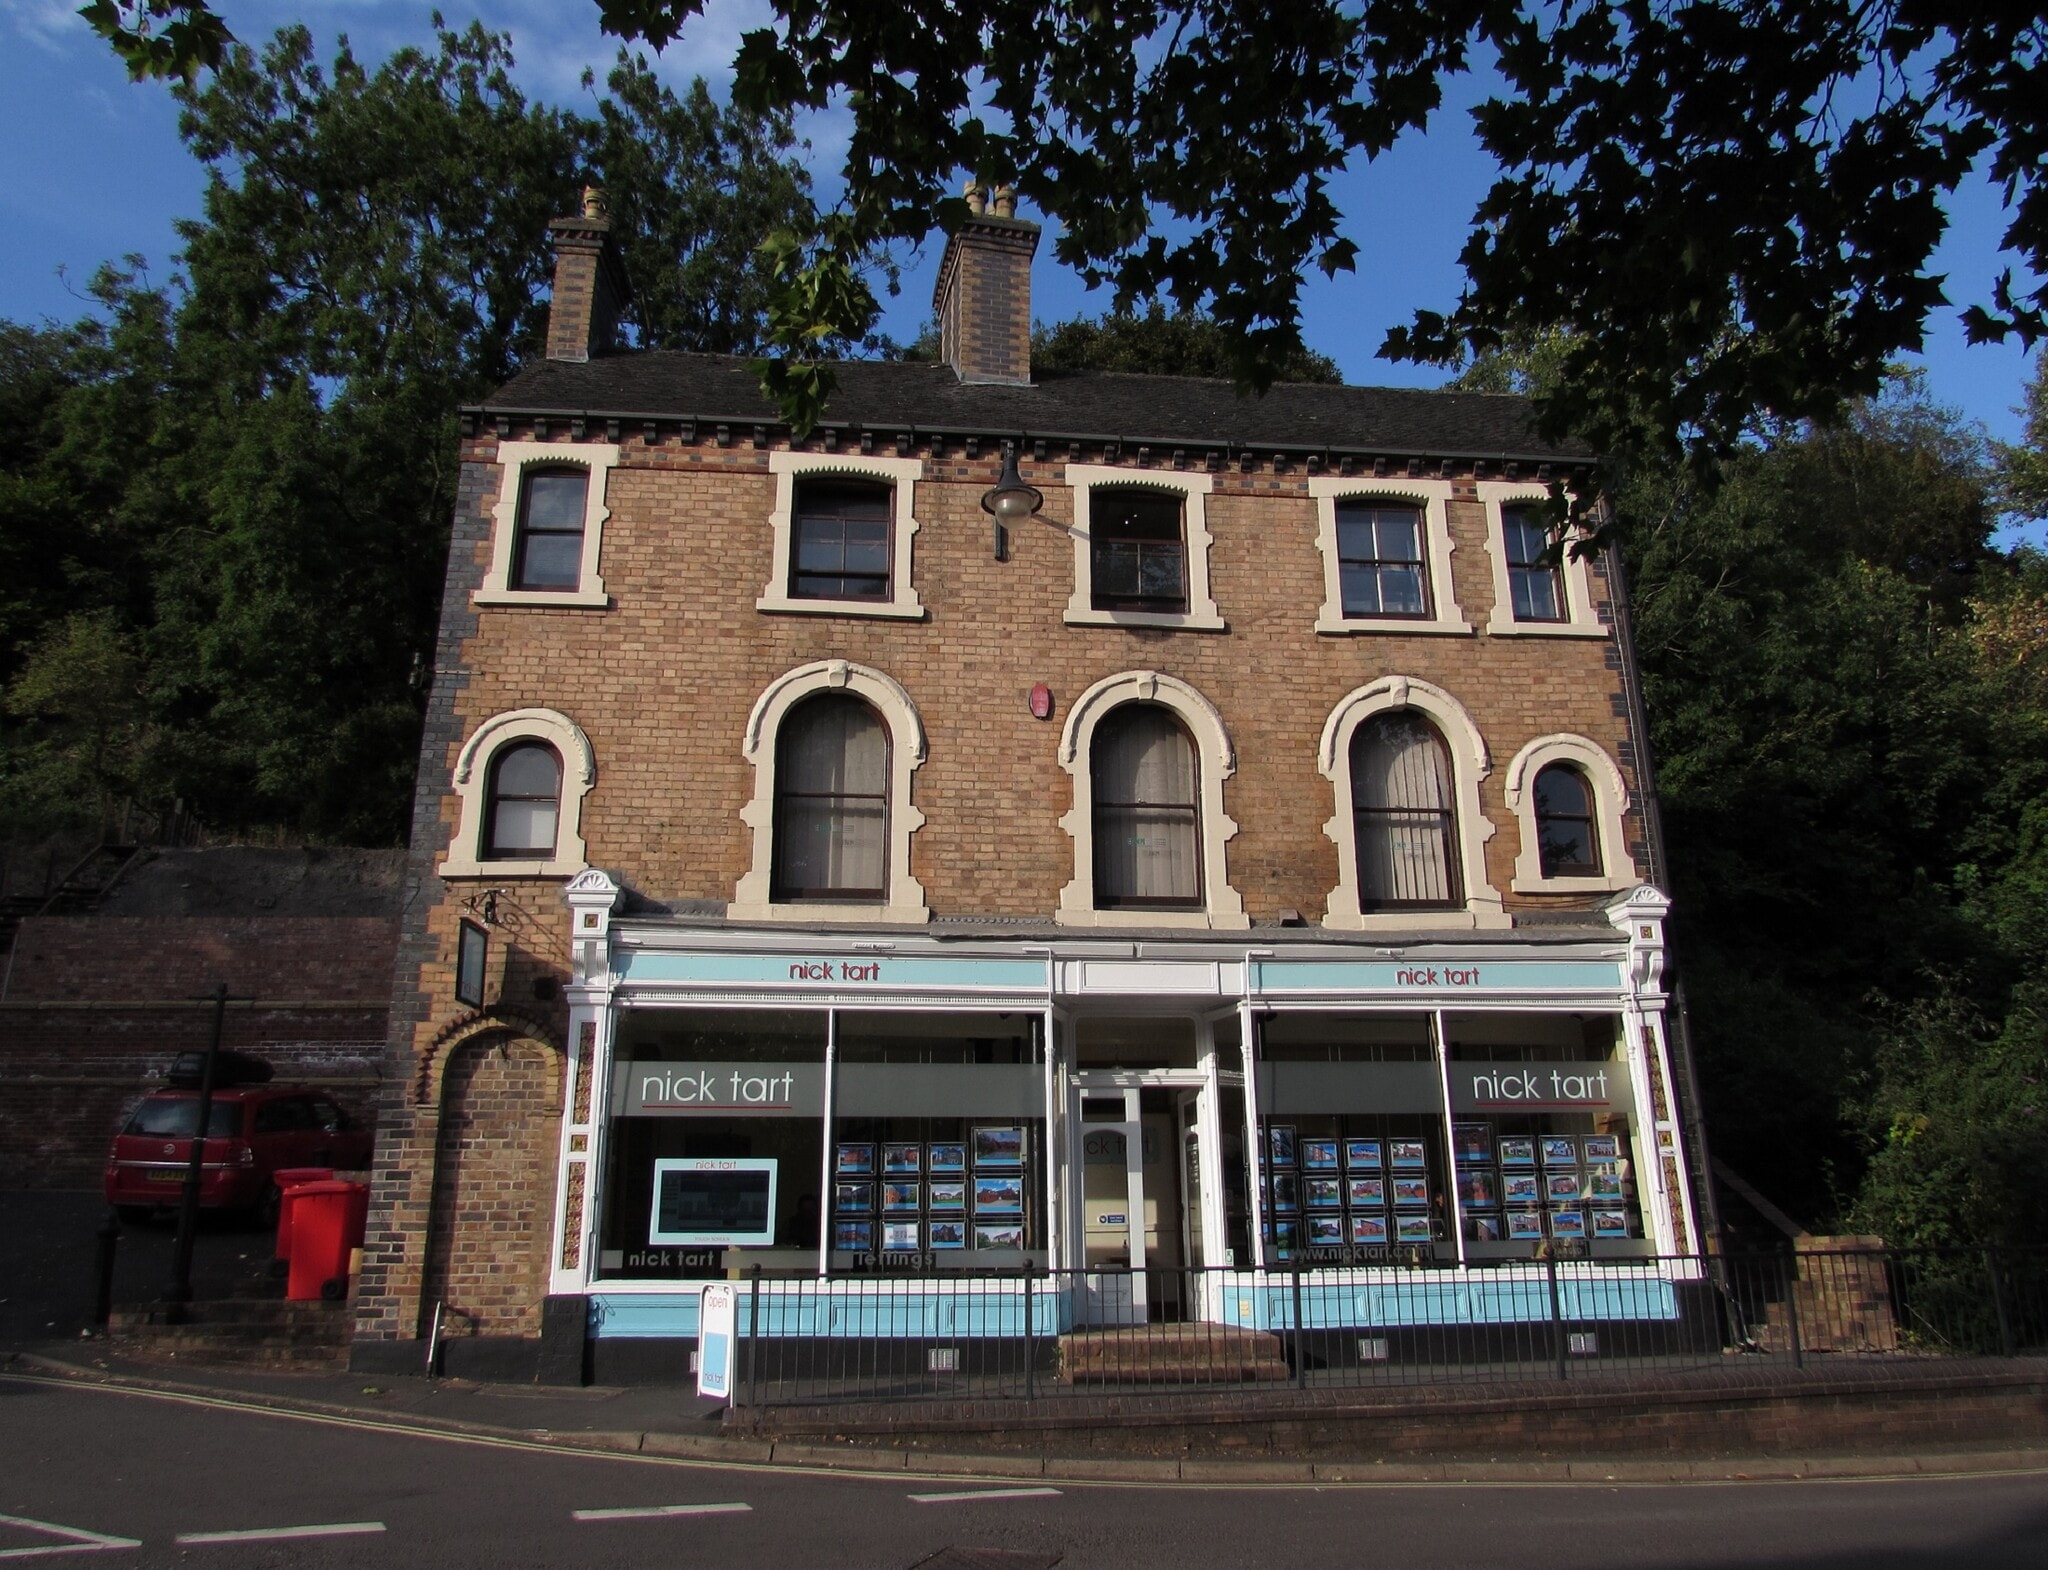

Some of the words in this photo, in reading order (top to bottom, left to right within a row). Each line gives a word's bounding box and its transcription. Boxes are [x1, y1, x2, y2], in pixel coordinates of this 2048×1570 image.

[789, 961, 834, 980] nick
[841, 962, 880, 980] tart
[1396, 967, 1438, 986] nick
[1443, 967, 1480, 986] tart
[642, 1070, 716, 1102] nick
[729, 1070, 794, 1102] tart
[1473, 1069, 1540, 1100] nick
[1550, 1069, 1608, 1100] tart
[695, 1160, 716, 1169] nick
[718, 1160, 737, 1169] tart
[629, 1249, 671, 1267] nick
[678, 1249, 714, 1267] tart
[858, 1250, 933, 1269] lettings
[708, 1296, 727, 1309] open
